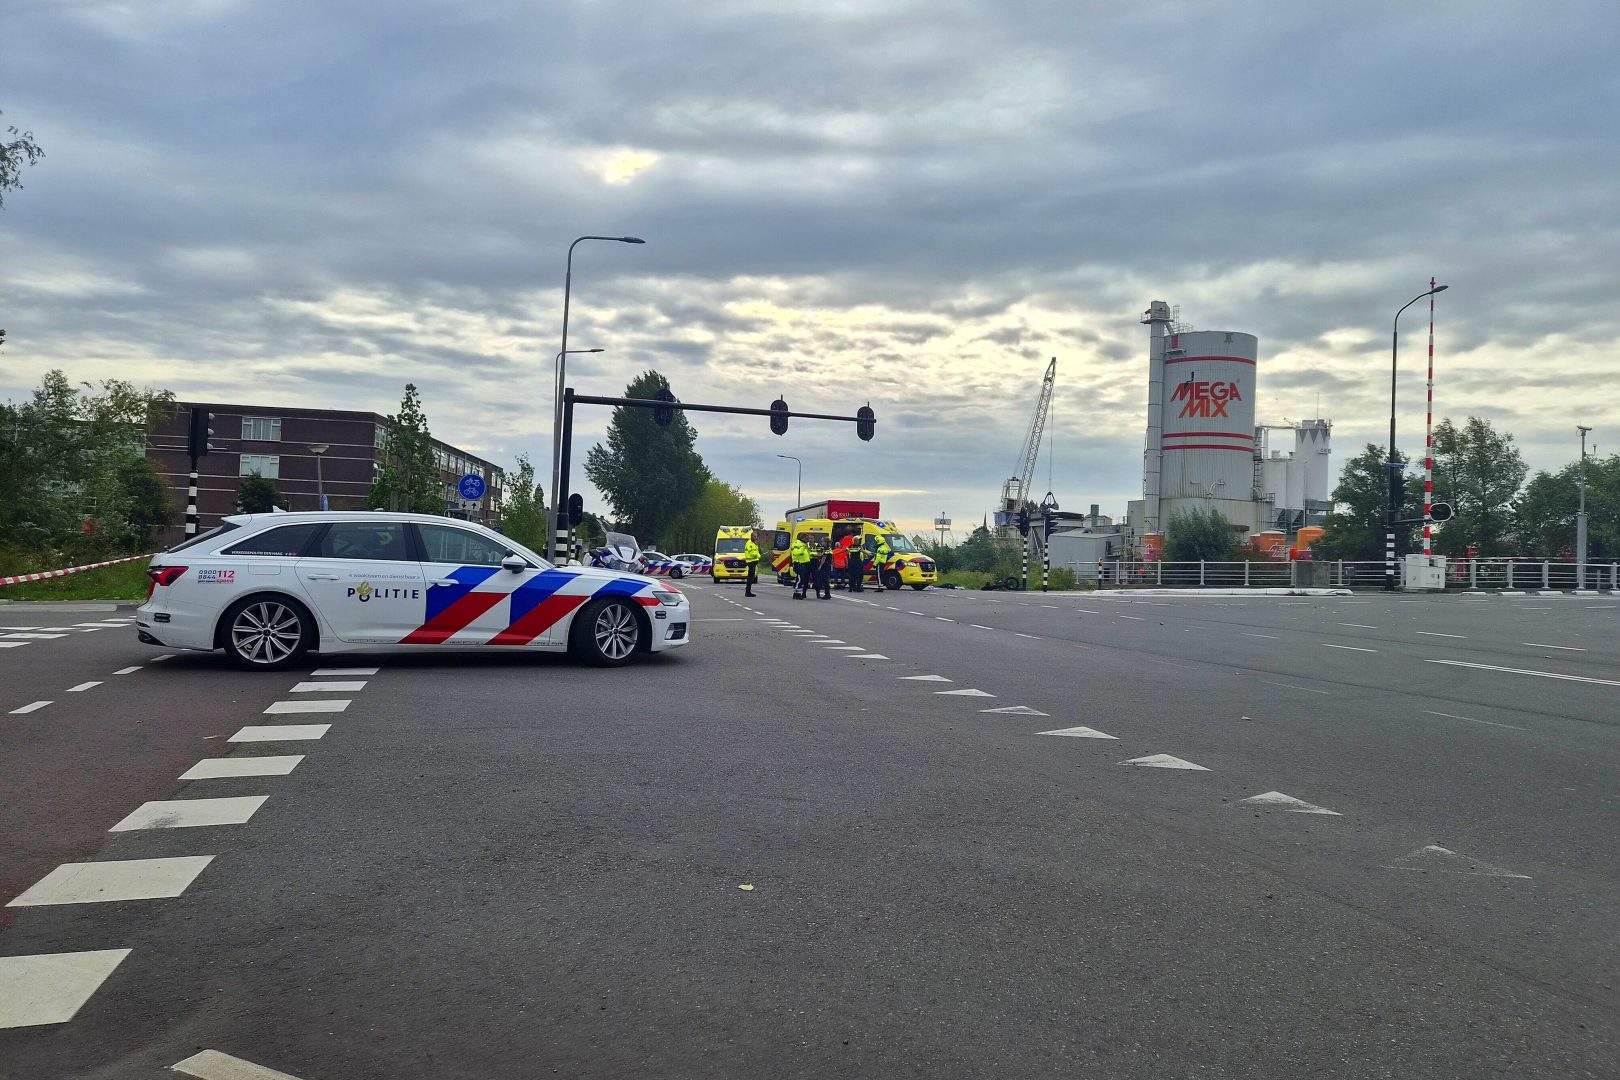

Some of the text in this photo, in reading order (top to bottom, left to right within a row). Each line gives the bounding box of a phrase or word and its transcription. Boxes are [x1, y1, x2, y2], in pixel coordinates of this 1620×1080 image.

[1170, 381, 1242, 401] MEGA
[1179, 400, 1229, 418] MIX
[217, 570, 236, 578] 112
[347, 586, 419, 602] POLITIE
